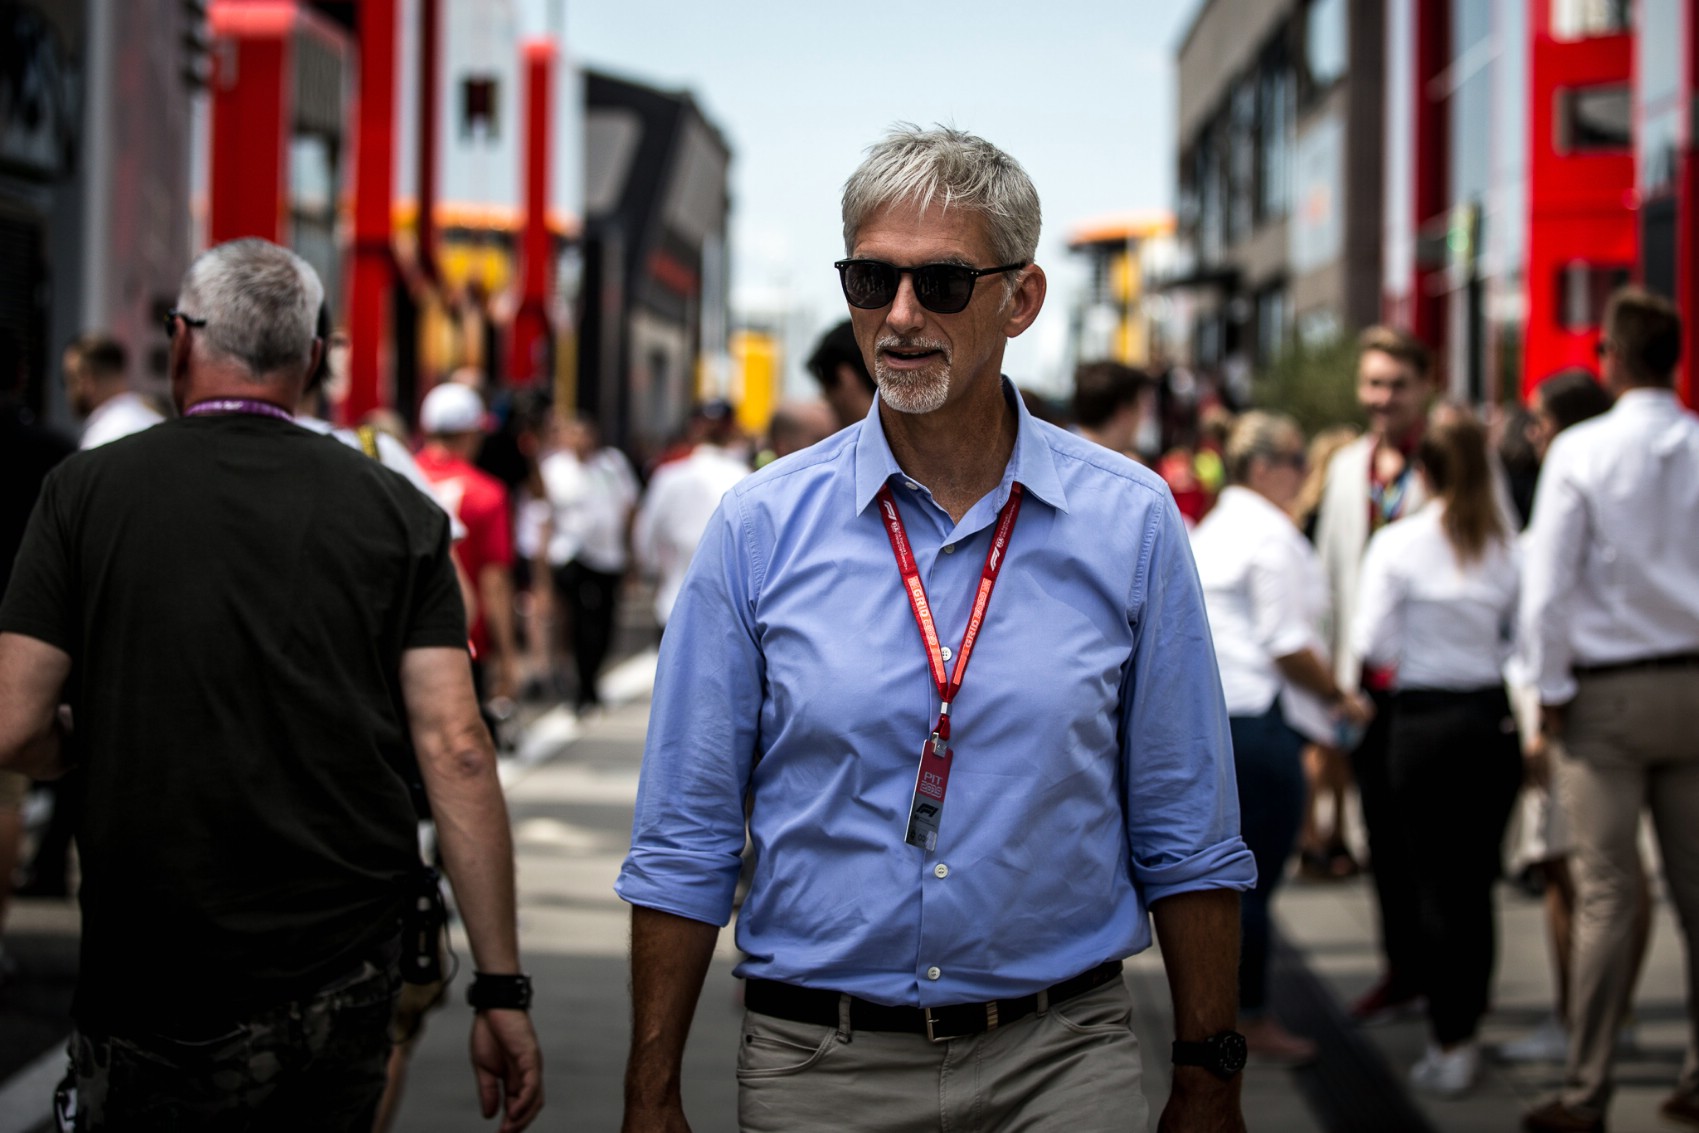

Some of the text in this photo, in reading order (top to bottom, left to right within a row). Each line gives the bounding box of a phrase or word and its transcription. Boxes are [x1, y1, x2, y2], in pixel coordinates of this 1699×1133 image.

[913, 589, 929, 617] GRID
[965, 620, 980, 648] GRID
[924, 771, 943, 785] PIT
